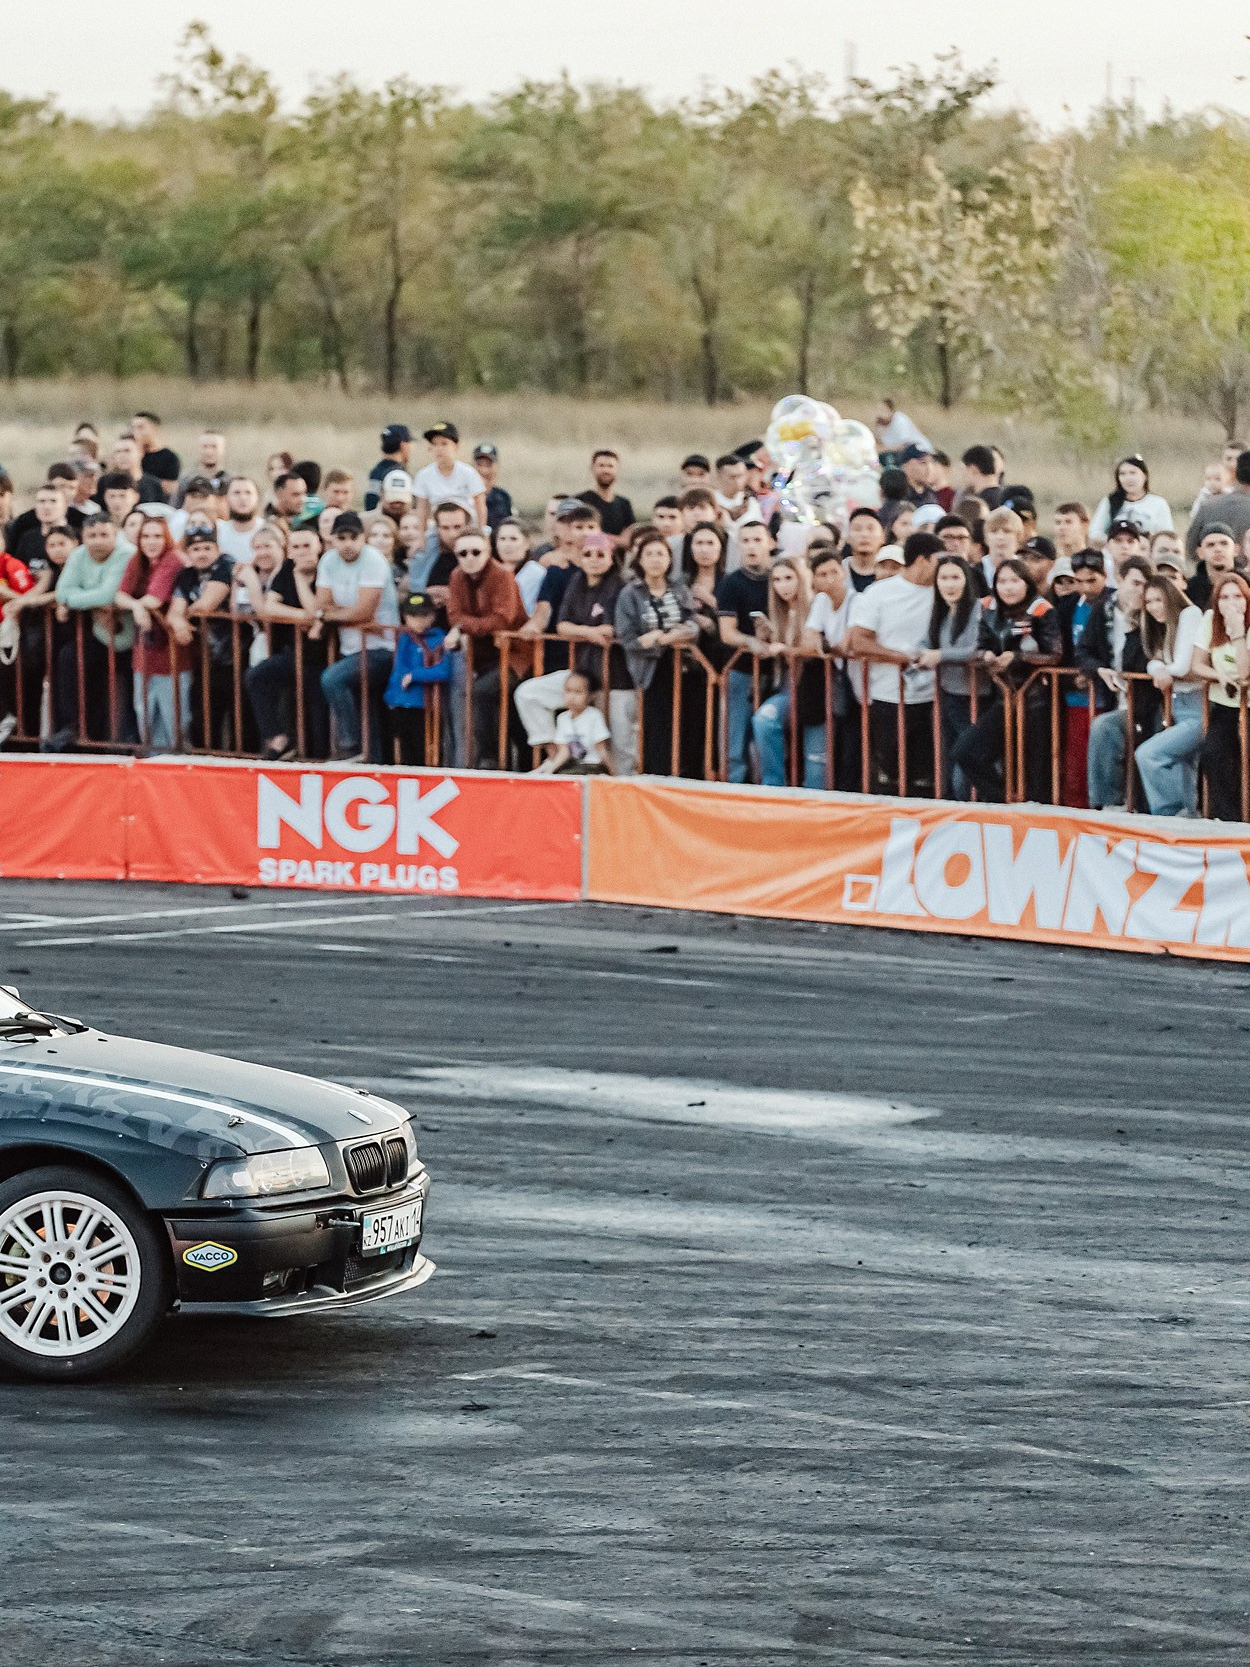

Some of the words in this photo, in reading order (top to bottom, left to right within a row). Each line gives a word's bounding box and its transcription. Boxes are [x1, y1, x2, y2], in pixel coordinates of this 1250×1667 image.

[258, 774, 461, 858] NGK
[258, 857, 355, 886] SPARK
[360, 862, 460, 892] PLUGS
[191, 1252, 229, 1260] YACCO
